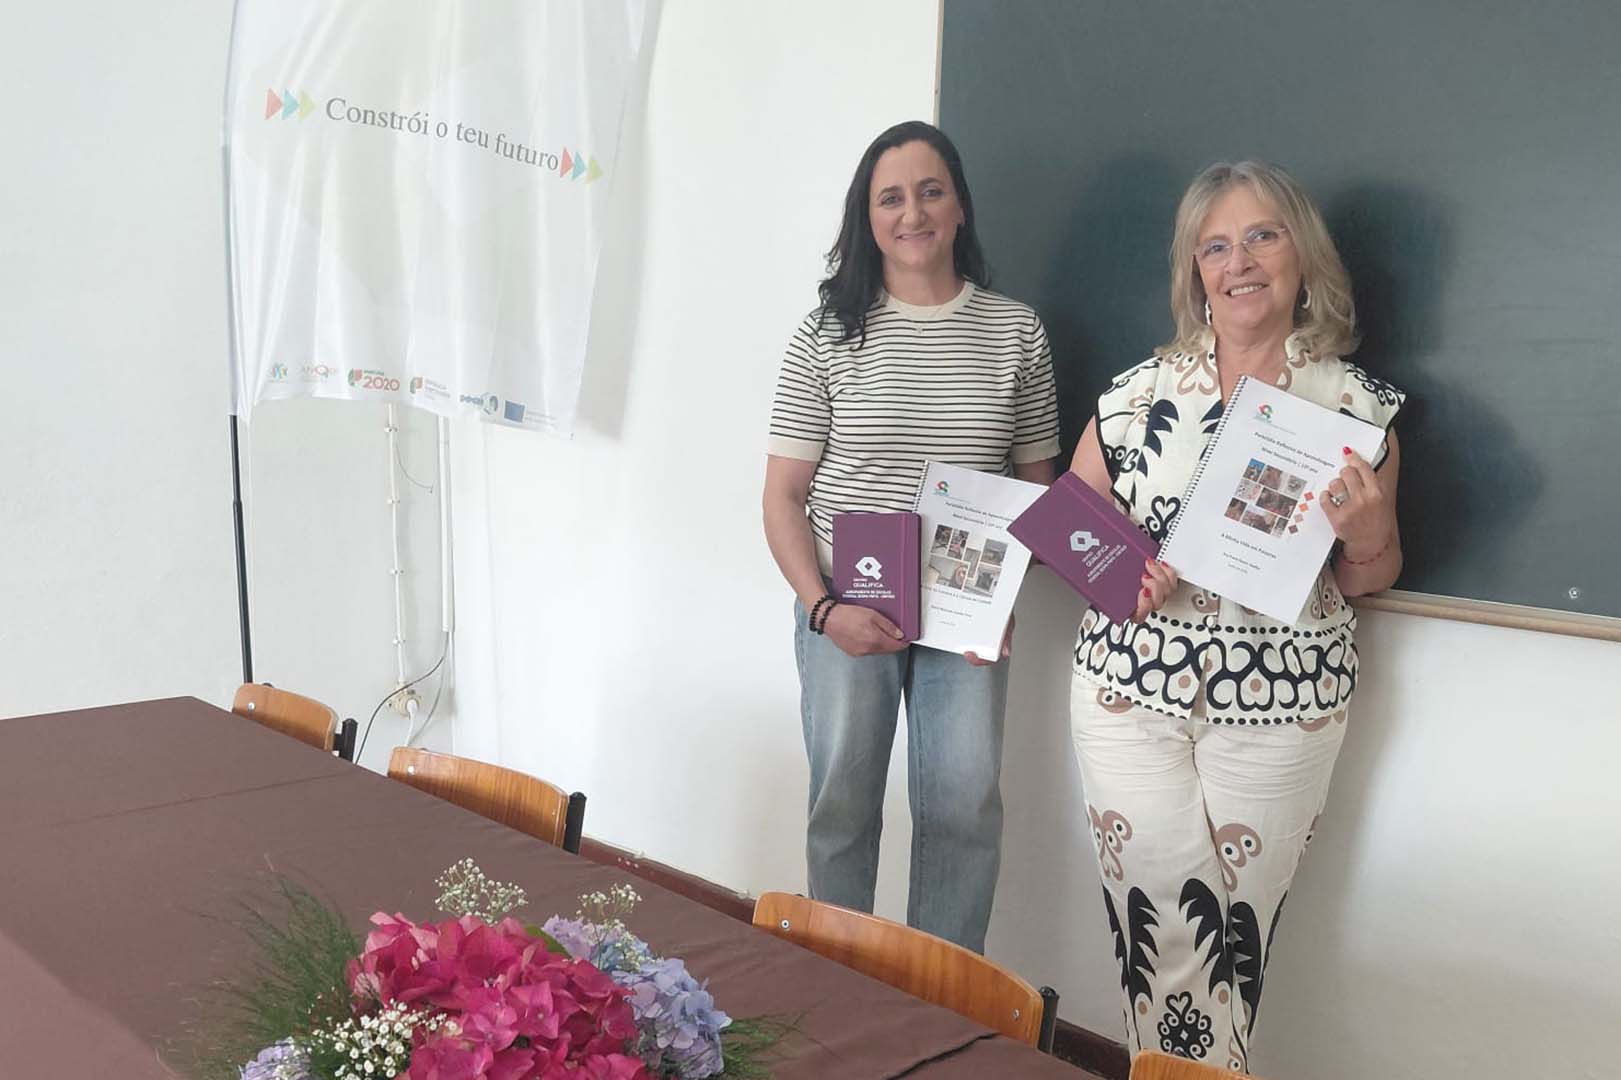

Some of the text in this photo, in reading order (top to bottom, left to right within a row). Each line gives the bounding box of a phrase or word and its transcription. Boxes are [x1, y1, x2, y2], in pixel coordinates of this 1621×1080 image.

[326, 97, 559, 170] Constrói o teu futuro
[362, 376, 400, 392] 2020
[1085, 544, 1110, 568] QUALIFICA
